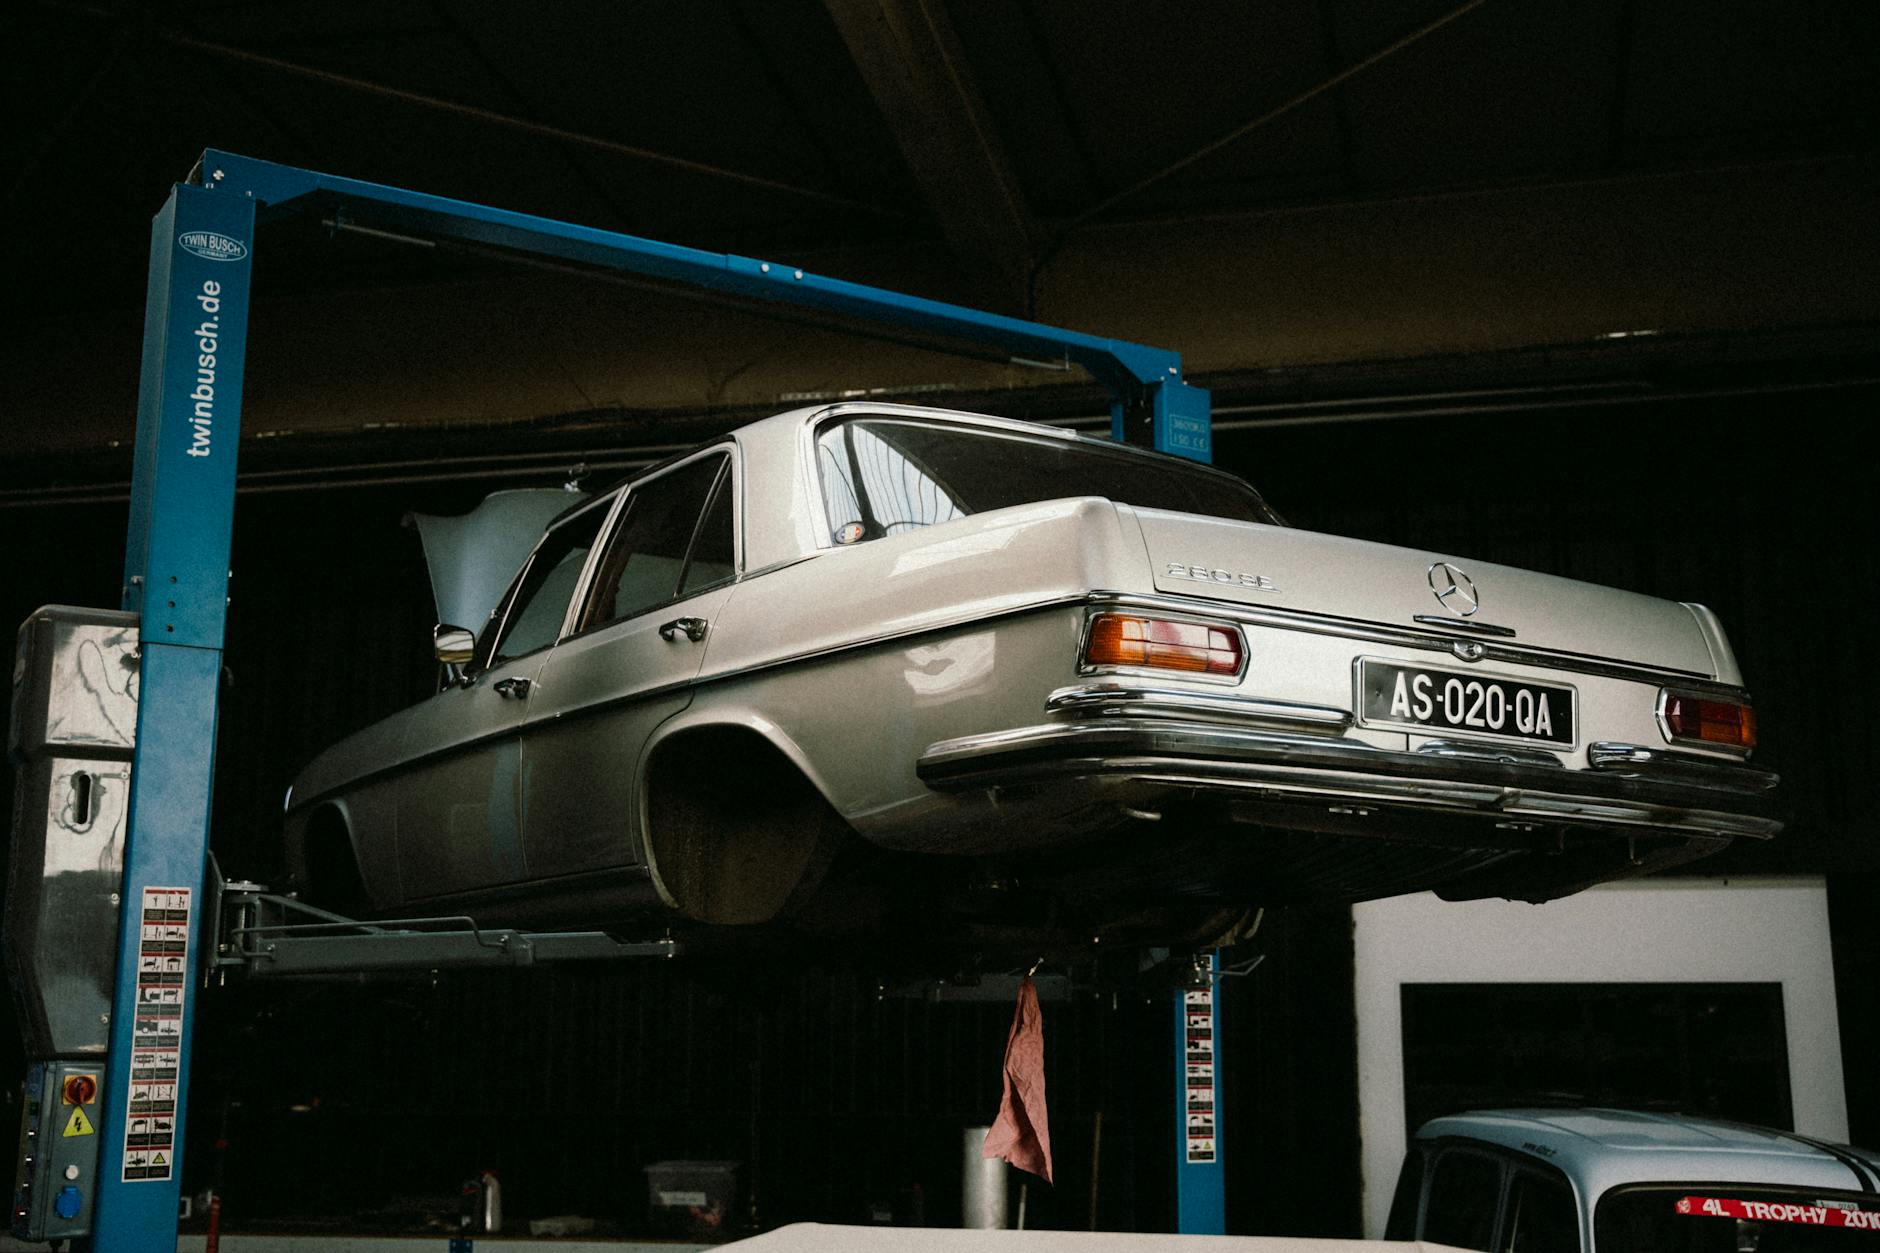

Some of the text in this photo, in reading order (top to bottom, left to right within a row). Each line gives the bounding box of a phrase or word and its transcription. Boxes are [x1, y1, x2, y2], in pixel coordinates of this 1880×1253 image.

[184, 234, 241, 254] TWIN BUSCH
[186, 280, 221, 457] twinbusch.de
[1166, 562, 1277, 590] 280 SE
[1390, 671, 1553, 737] AS-020-QA
[1702, 1198, 1730, 1217] 4L
[1740, 1201, 1828, 1225] TROPHY
